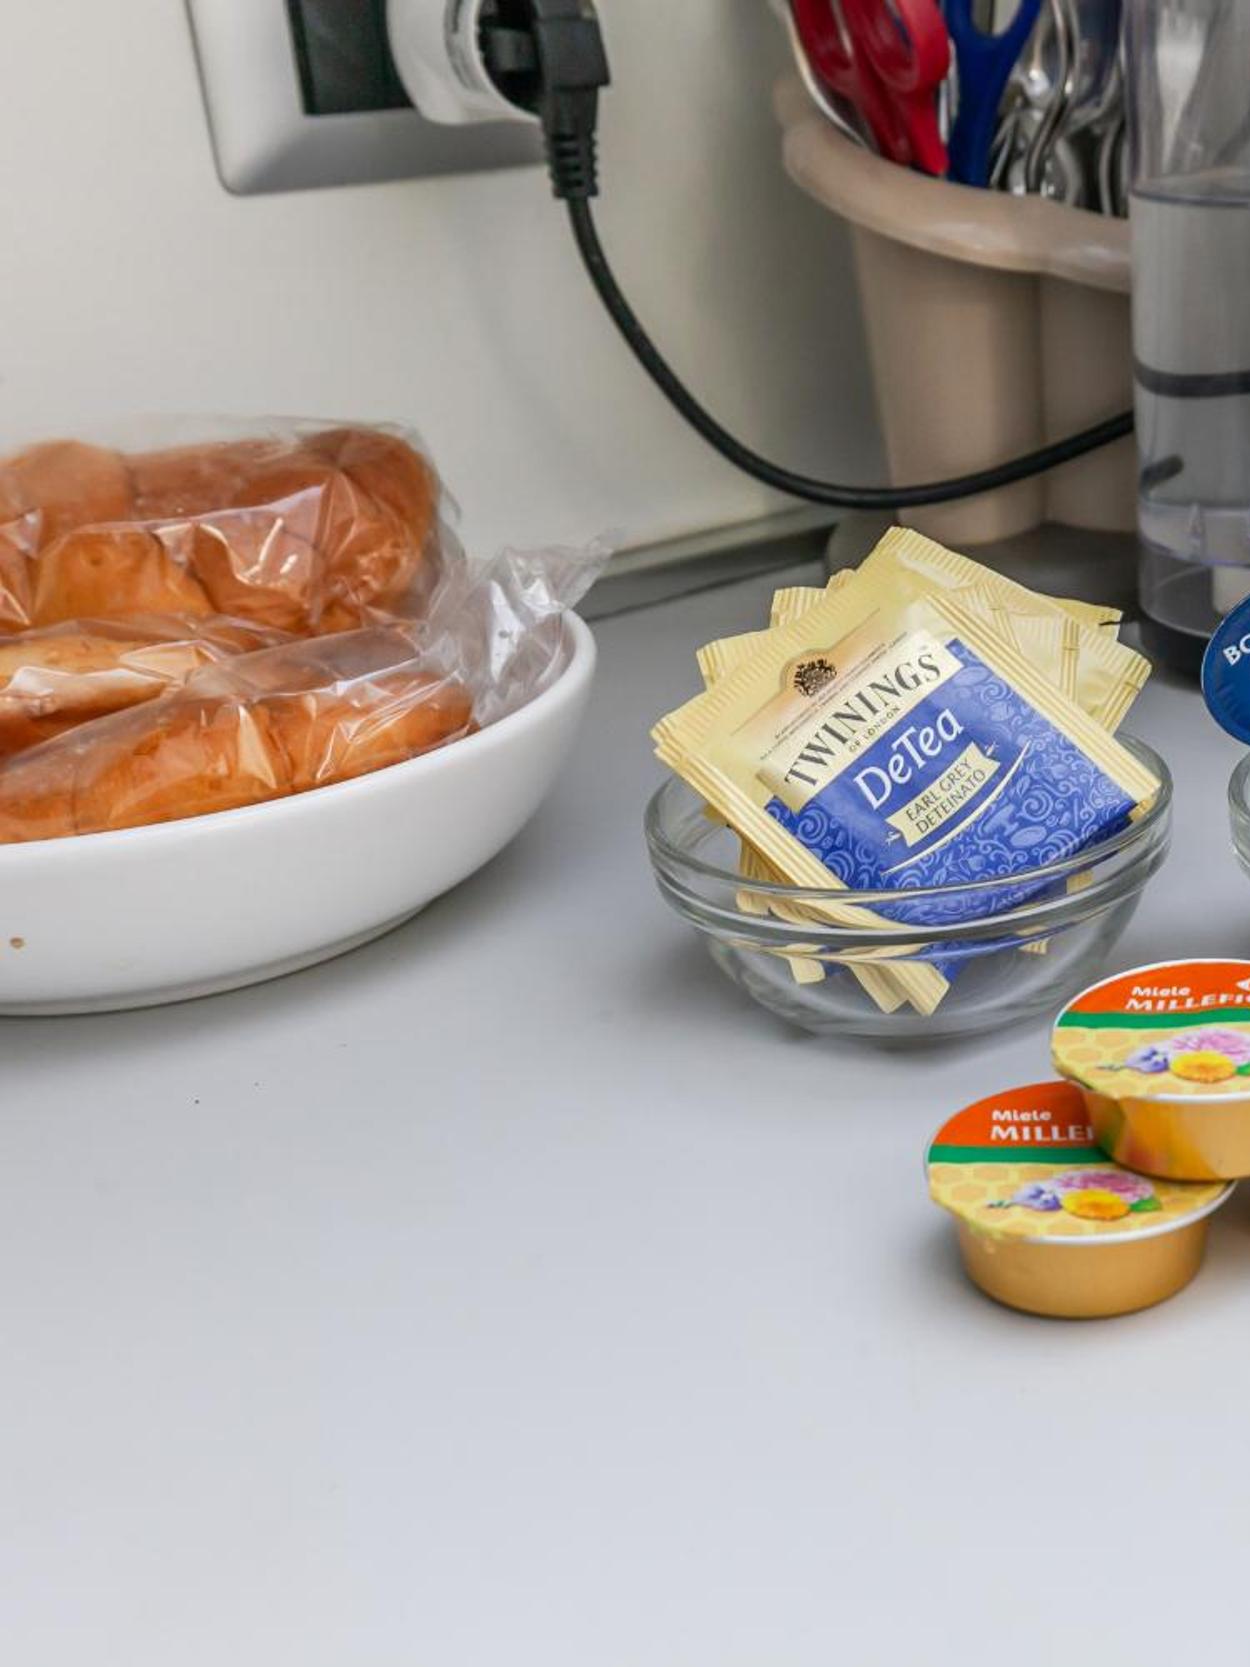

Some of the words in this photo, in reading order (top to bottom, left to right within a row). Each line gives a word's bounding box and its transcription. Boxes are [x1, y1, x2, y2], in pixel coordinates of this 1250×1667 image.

[784, 653, 941, 787] TWININGS
[861, 706, 900, 739] LONDON
[853, 708, 964, 811] DeTea
[906, 790, 940, 821] EARL
[939, 757, 972, 793] GREY
[916, 769, 985, 834] DETEINATO
[1131, 986, 1191, 997] Miele
[991, 1109, 1052, 1121] Miele
